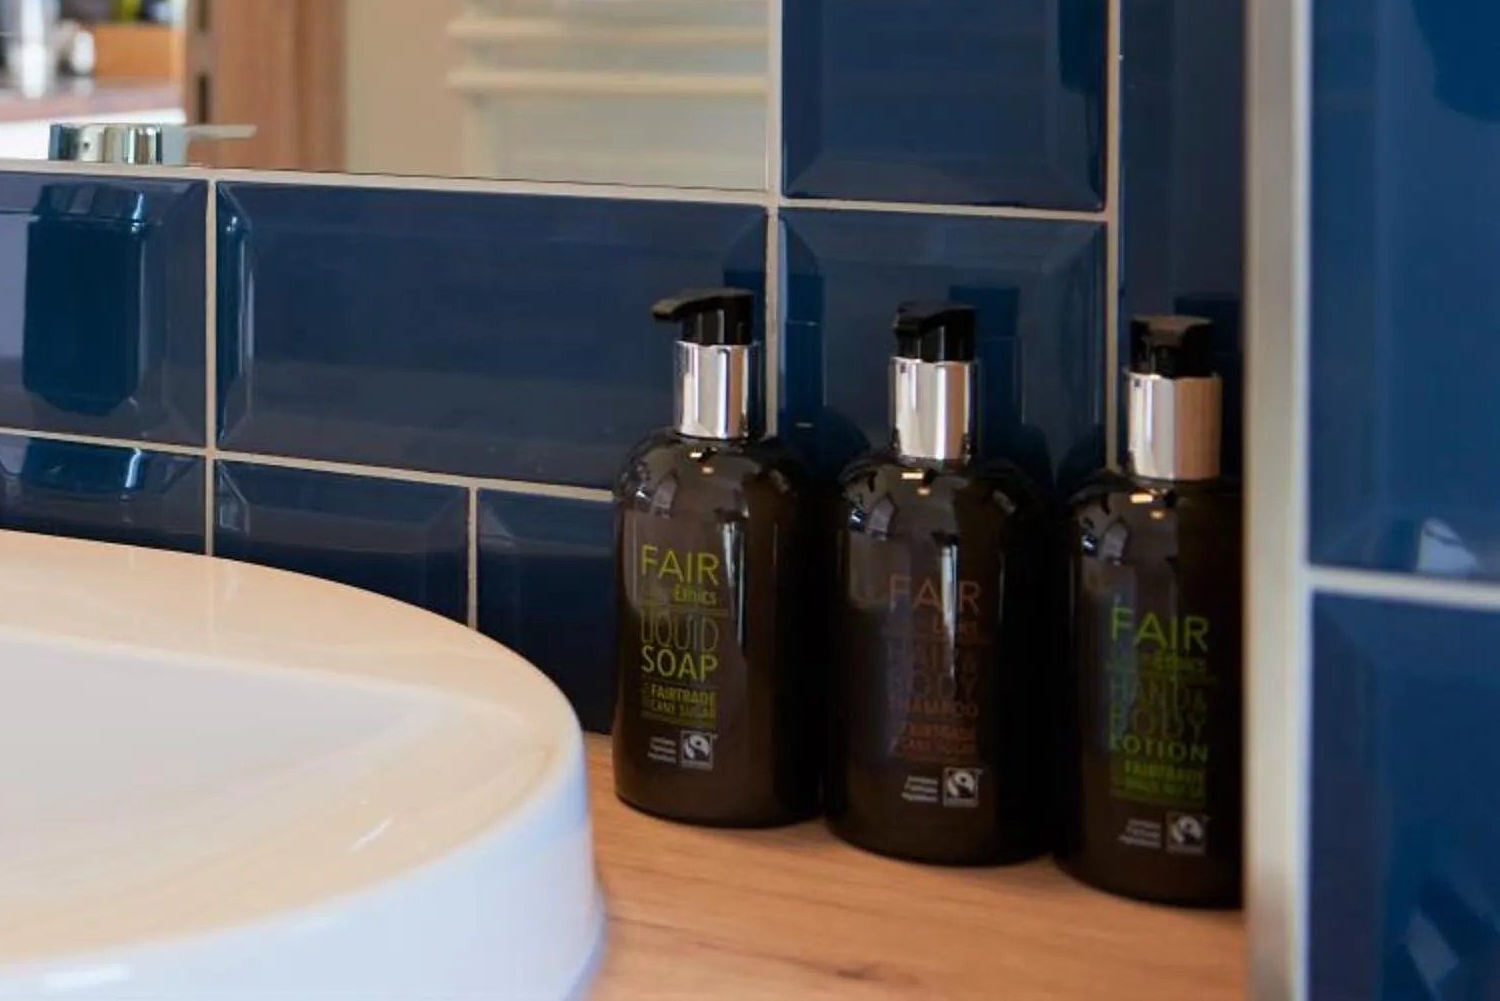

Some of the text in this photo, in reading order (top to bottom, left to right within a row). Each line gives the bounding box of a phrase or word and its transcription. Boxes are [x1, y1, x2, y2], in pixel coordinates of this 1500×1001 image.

[641, 544, 720, 587] FAIR
[888, 573, 981, 616] FAR
[640, 607, 719, 653] LIQUID
[1111, 605, 1209, 652] FAIR
[641, 645, 719, 683] SOAP
[1108, 732, 1209, 763] LOTION
